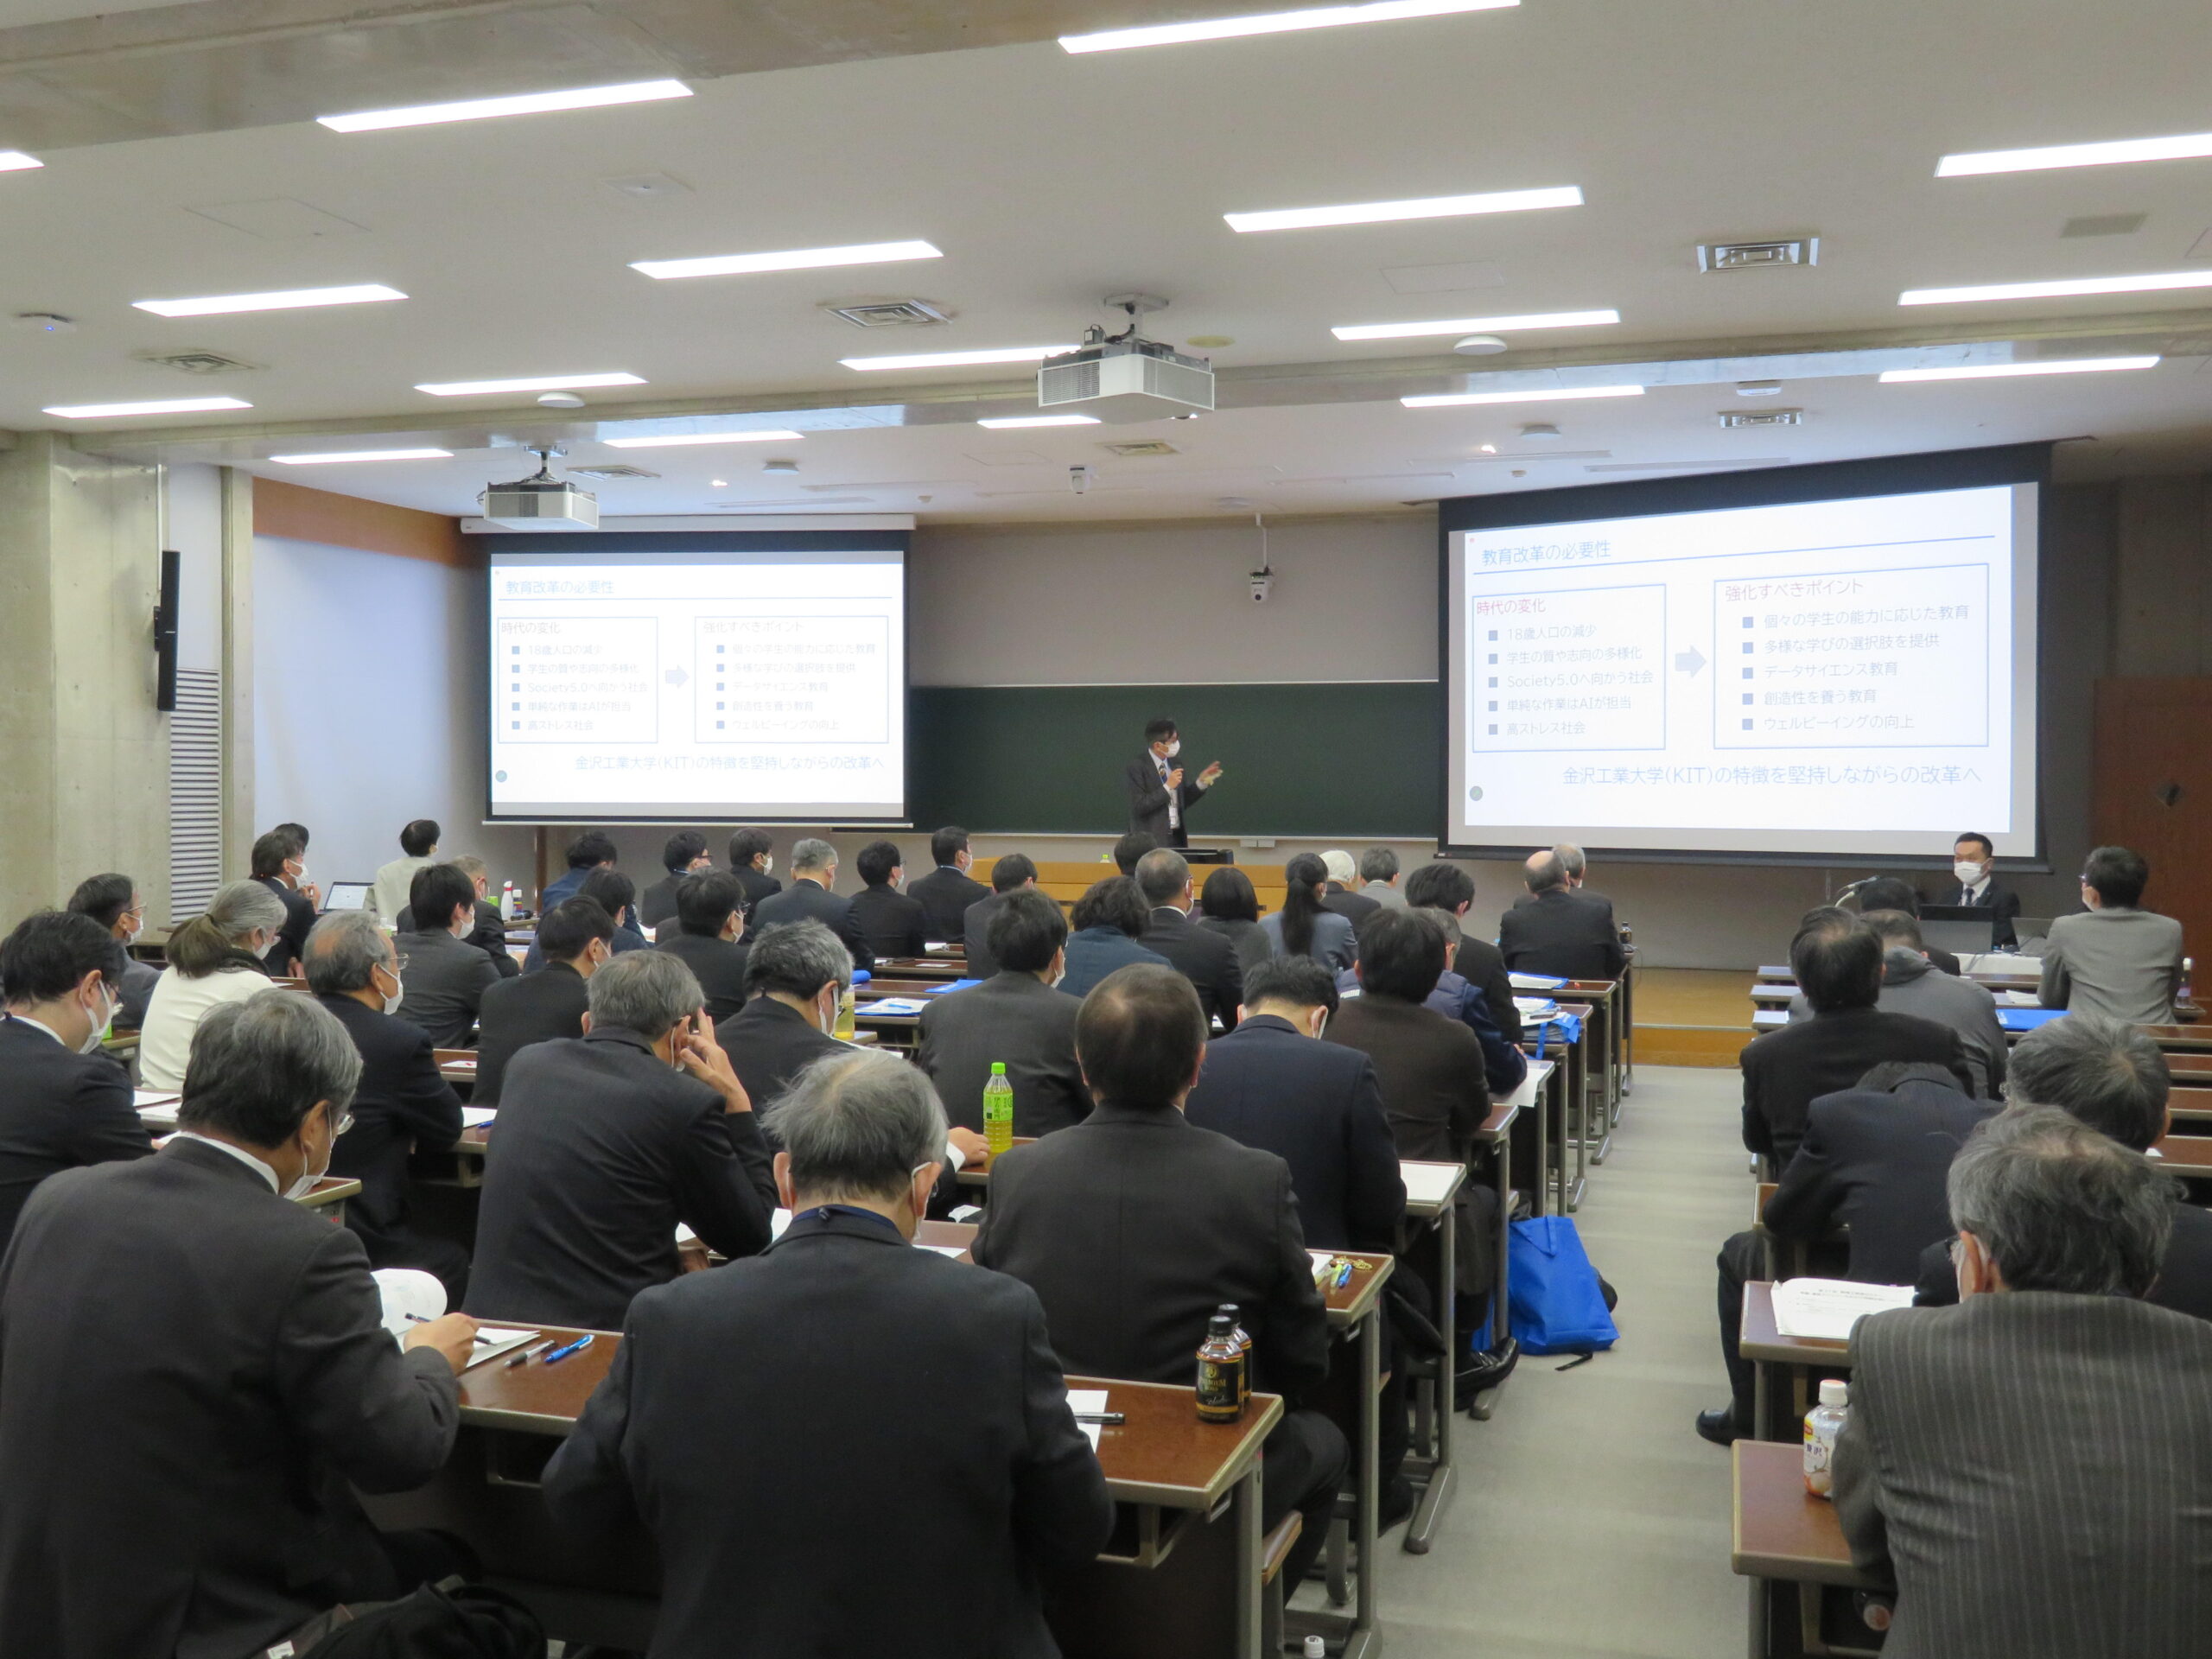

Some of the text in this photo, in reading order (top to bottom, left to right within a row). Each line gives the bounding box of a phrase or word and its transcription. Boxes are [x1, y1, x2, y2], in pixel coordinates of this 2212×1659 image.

[1481, 540, 1611, 566] 教育改革の必要性
[505, 580, 614, 594] 教育改革の必要性
[1725, 577, 1865, 601] 強化すべきポイント
[1476, 598, 1547, 615] 時代の変化
[1764, 605, 1970, 628] 個々の学生の能力に応じた教育
[500, 621, 561, 634] 時代の変化
[1507, 625, 1598, 640] 18歳人口の減少
[1764, 632, 1941, 654] 多様な学びの選択肢を提供
[1506, 646, 1643, 665] 学生の質や志向の多様化
[1764, 661, 1899, 678] データサイエンス教育
[1507, 670, 1654, 690] Society5.0へ向かう社会
[1506, 695, 1632, 713] 単純な作業はAIが担当
[1764, 689, 1878, 706] 創造性を養う教育
[1506, 721, 1586, 736] 高ストレス社会
[1764, 714, 1916, 731] ウェルビーイングの向上
[1562, 765, 1982, 785] 金沢工業大学(KIT)の特徴を堅持しながらの改革へ
